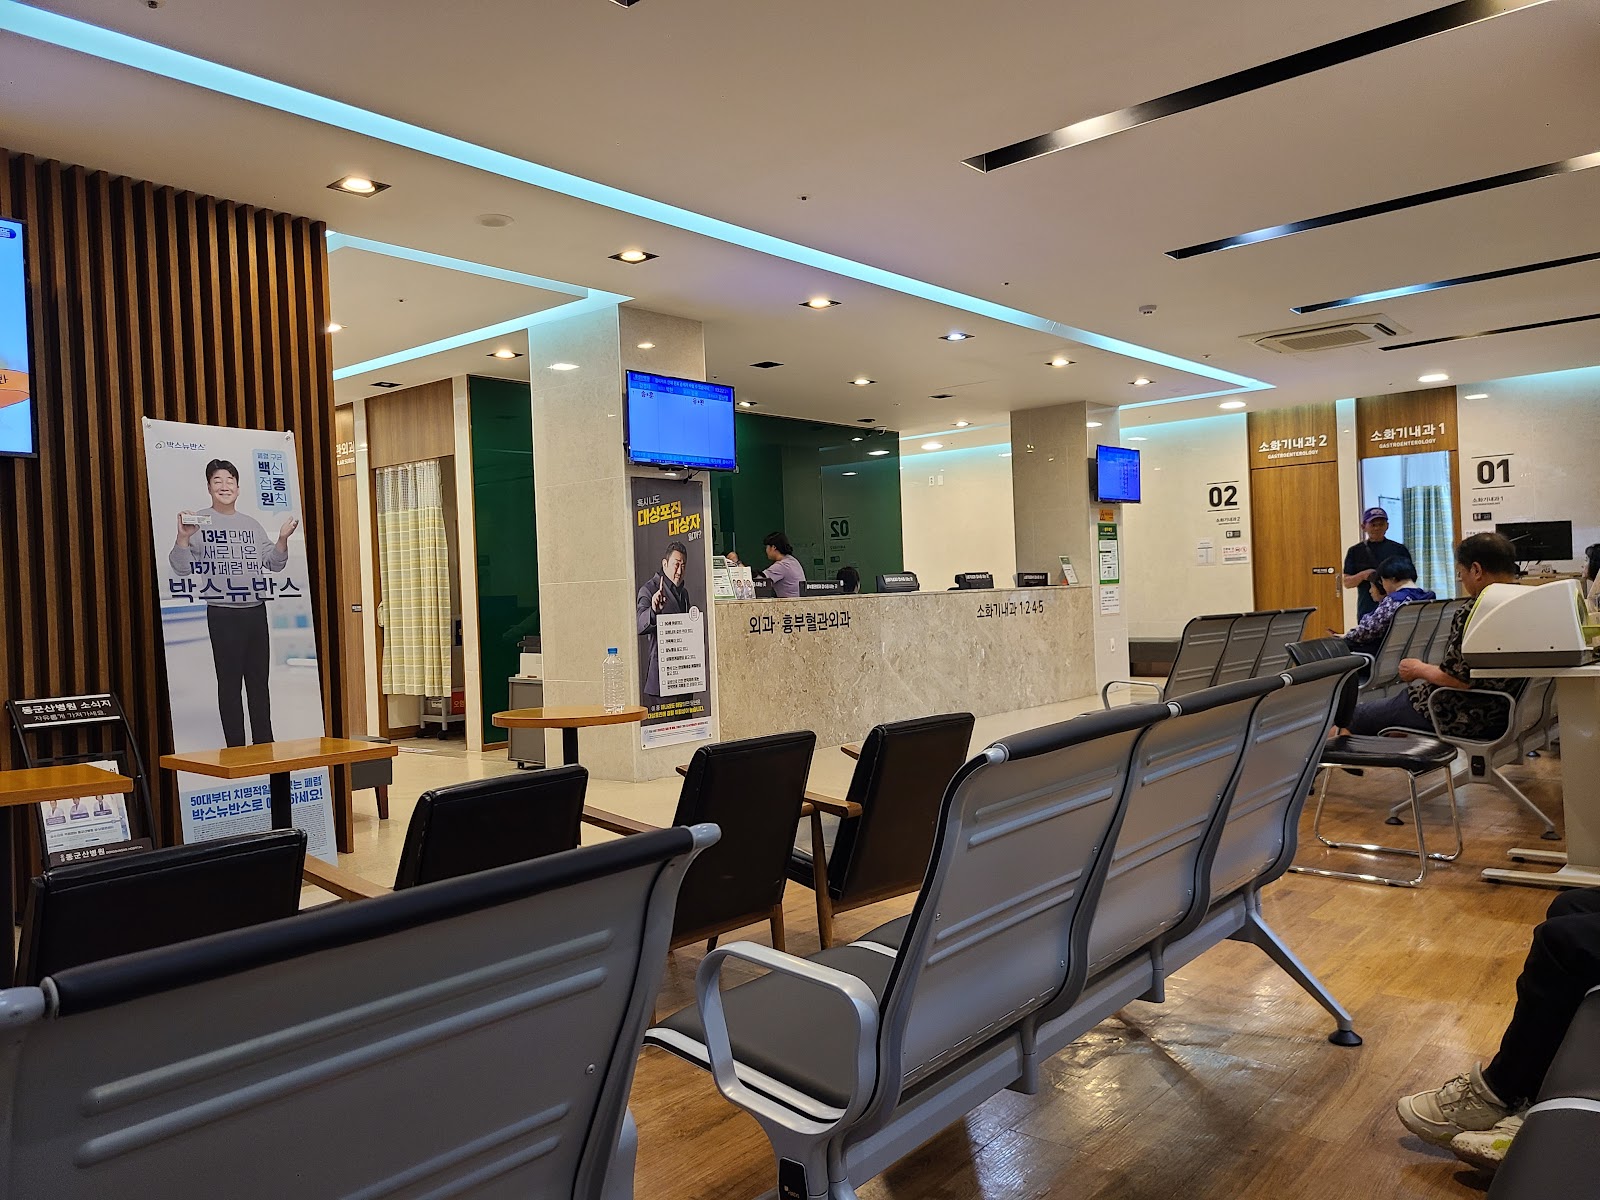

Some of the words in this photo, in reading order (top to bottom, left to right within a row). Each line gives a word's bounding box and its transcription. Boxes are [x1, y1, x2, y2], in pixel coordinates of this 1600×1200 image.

[1370, 423, 1436, 442] 소화기내과
[1438, 422, 1445, 435] 1
[166, 441, 206, 451] 박스뉴반스
[1258, 436, 1317, 453] 소화기내과
[1318, 434, 1328, 447] 2
[1379, 438, 1436, 449] GASTROENTEROLOGY
[1267, 449, 1319, 460] GASTROENTEROLOGY
[258, 461, 284, 476] 백신
[1477, 458, 1510, 485] 01
[260, 476, 286, 492] 접종
[261, 492, 288, 507] 원칙
[1208, 485, 1238, 508] 02
[637, 500, 682, 527] 대상포진
[668, 513, 701, 537] 대상자
[169, 577, 302, 603] 박스뉴반스
[976, 601, 1017, 619] 소화기내과
[22, 702, 77, 715] 동군산병원
[80, 699, 112, 709] 소식지
[190, 790, 232, 807] 50대부터
[192, 798, 264, 822] 박스뉴반스로
[65, 847, 106, 861] 동군산병원
